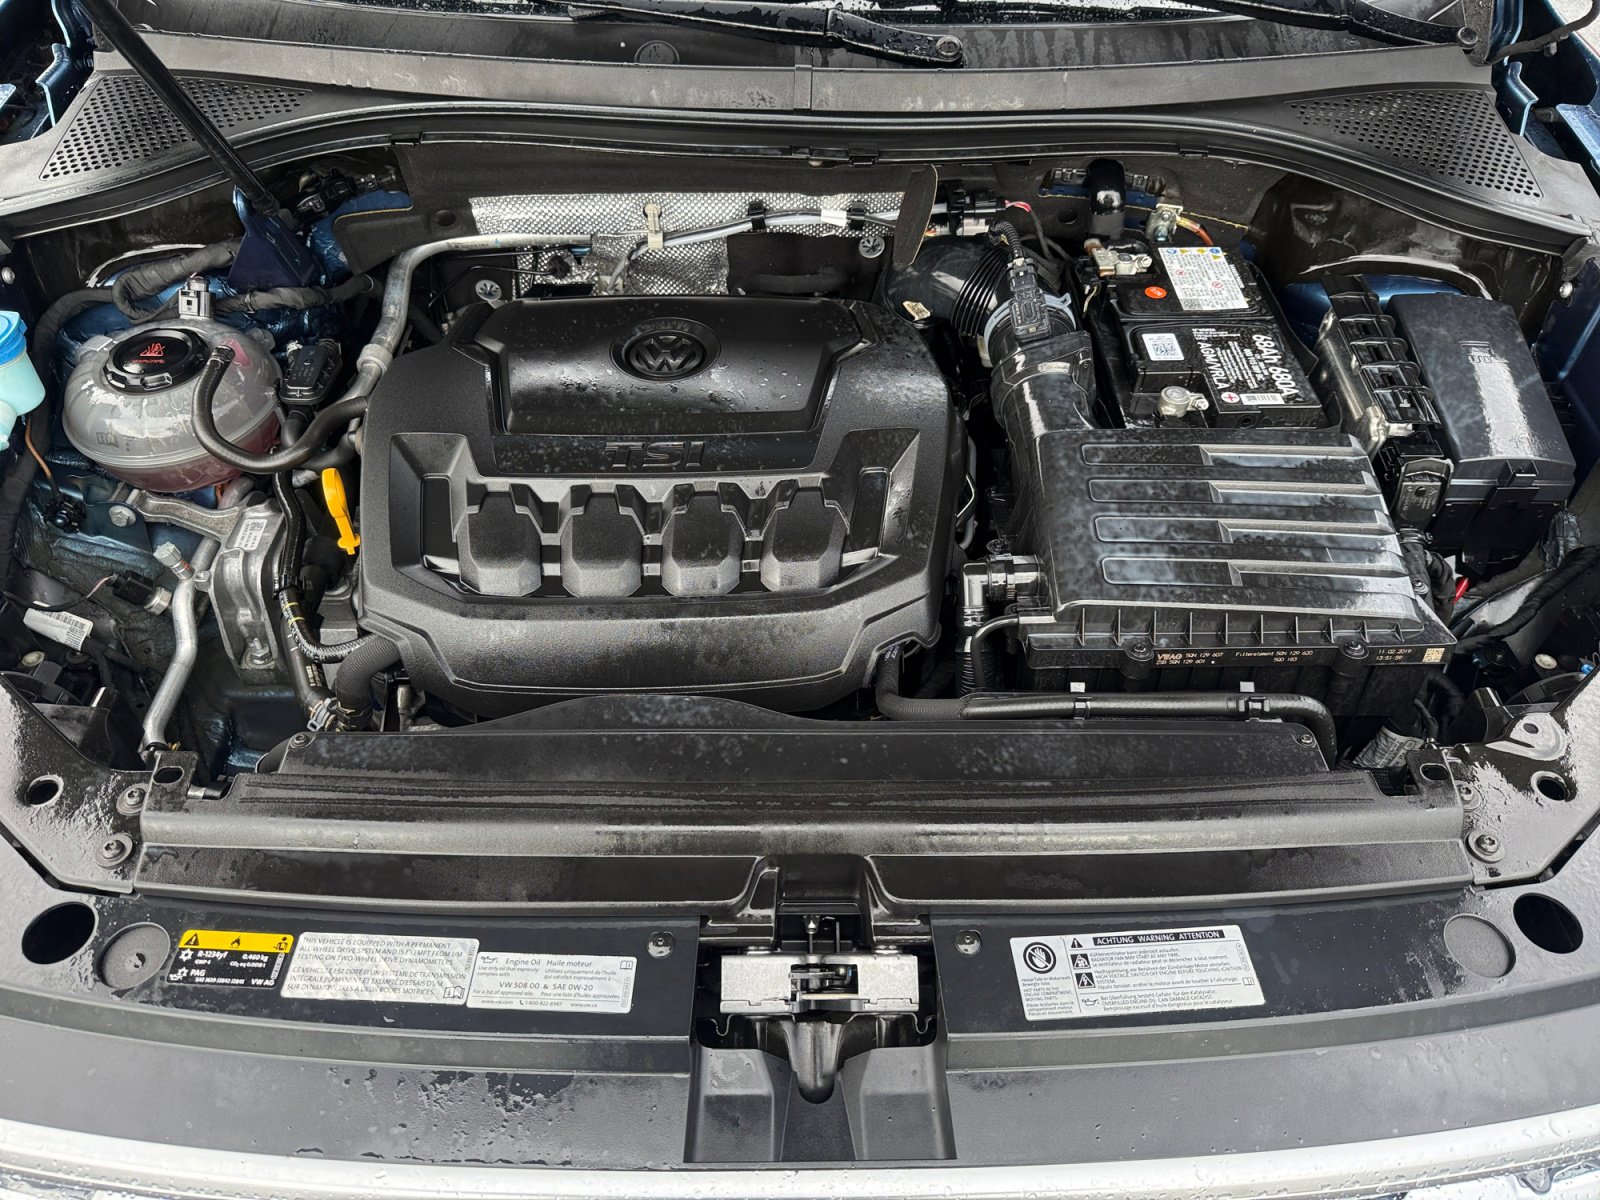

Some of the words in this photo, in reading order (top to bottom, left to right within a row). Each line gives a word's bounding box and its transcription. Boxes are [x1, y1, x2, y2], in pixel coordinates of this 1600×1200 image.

[1198, 342, 1230, 390] AGM/VRLA
[1252, 334, 1282, 364] 68Ah
[1268, 366, 1300, 396] 680A
[603, 441, 706, 468] TSI
[1095, 936, 1134, 944] ACHTUNG
[1136, 933, 1175, 942] WARNING
[1177, 930, 1219, 939] ATTENTION
[197, 950, 228, 960] R-1234yf
